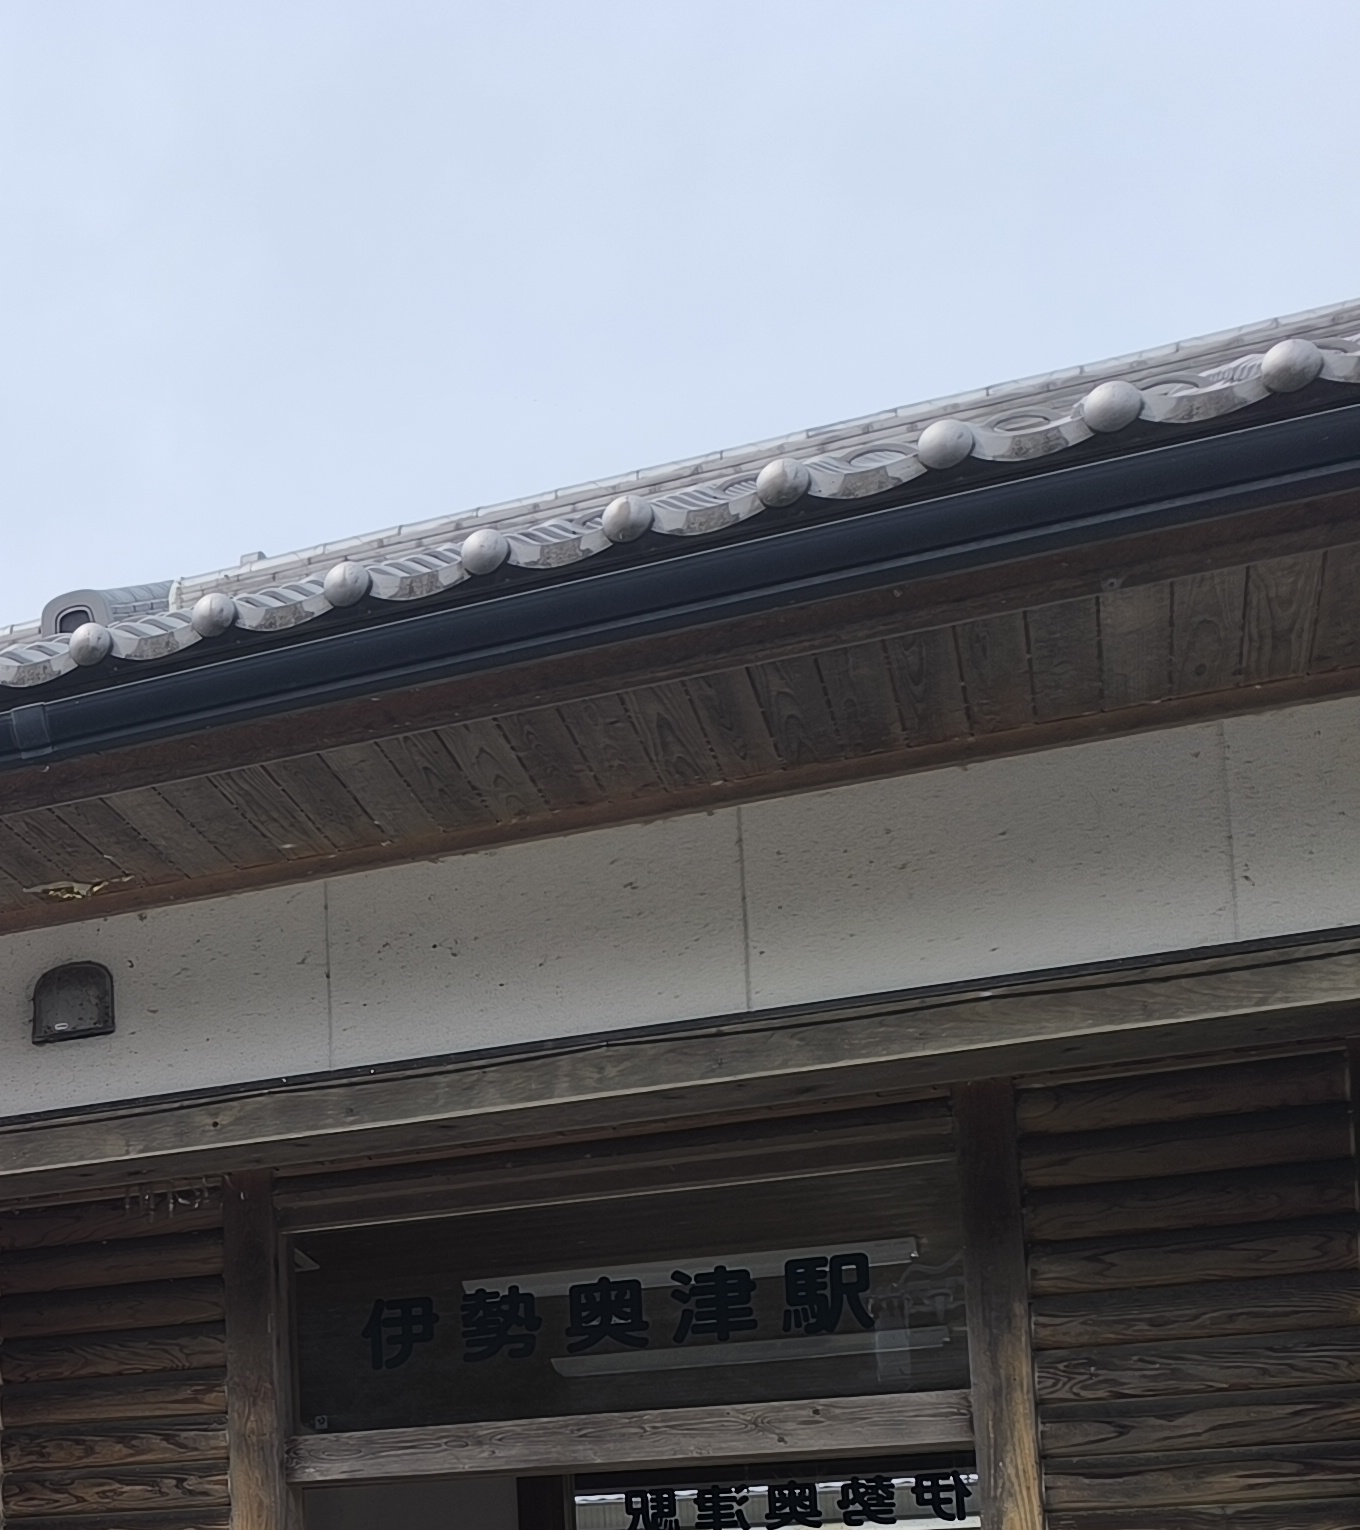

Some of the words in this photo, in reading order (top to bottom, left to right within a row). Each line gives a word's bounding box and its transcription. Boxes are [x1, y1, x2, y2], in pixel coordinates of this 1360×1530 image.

[361, 1252, 876, 1370] 伊勢奥津駅
